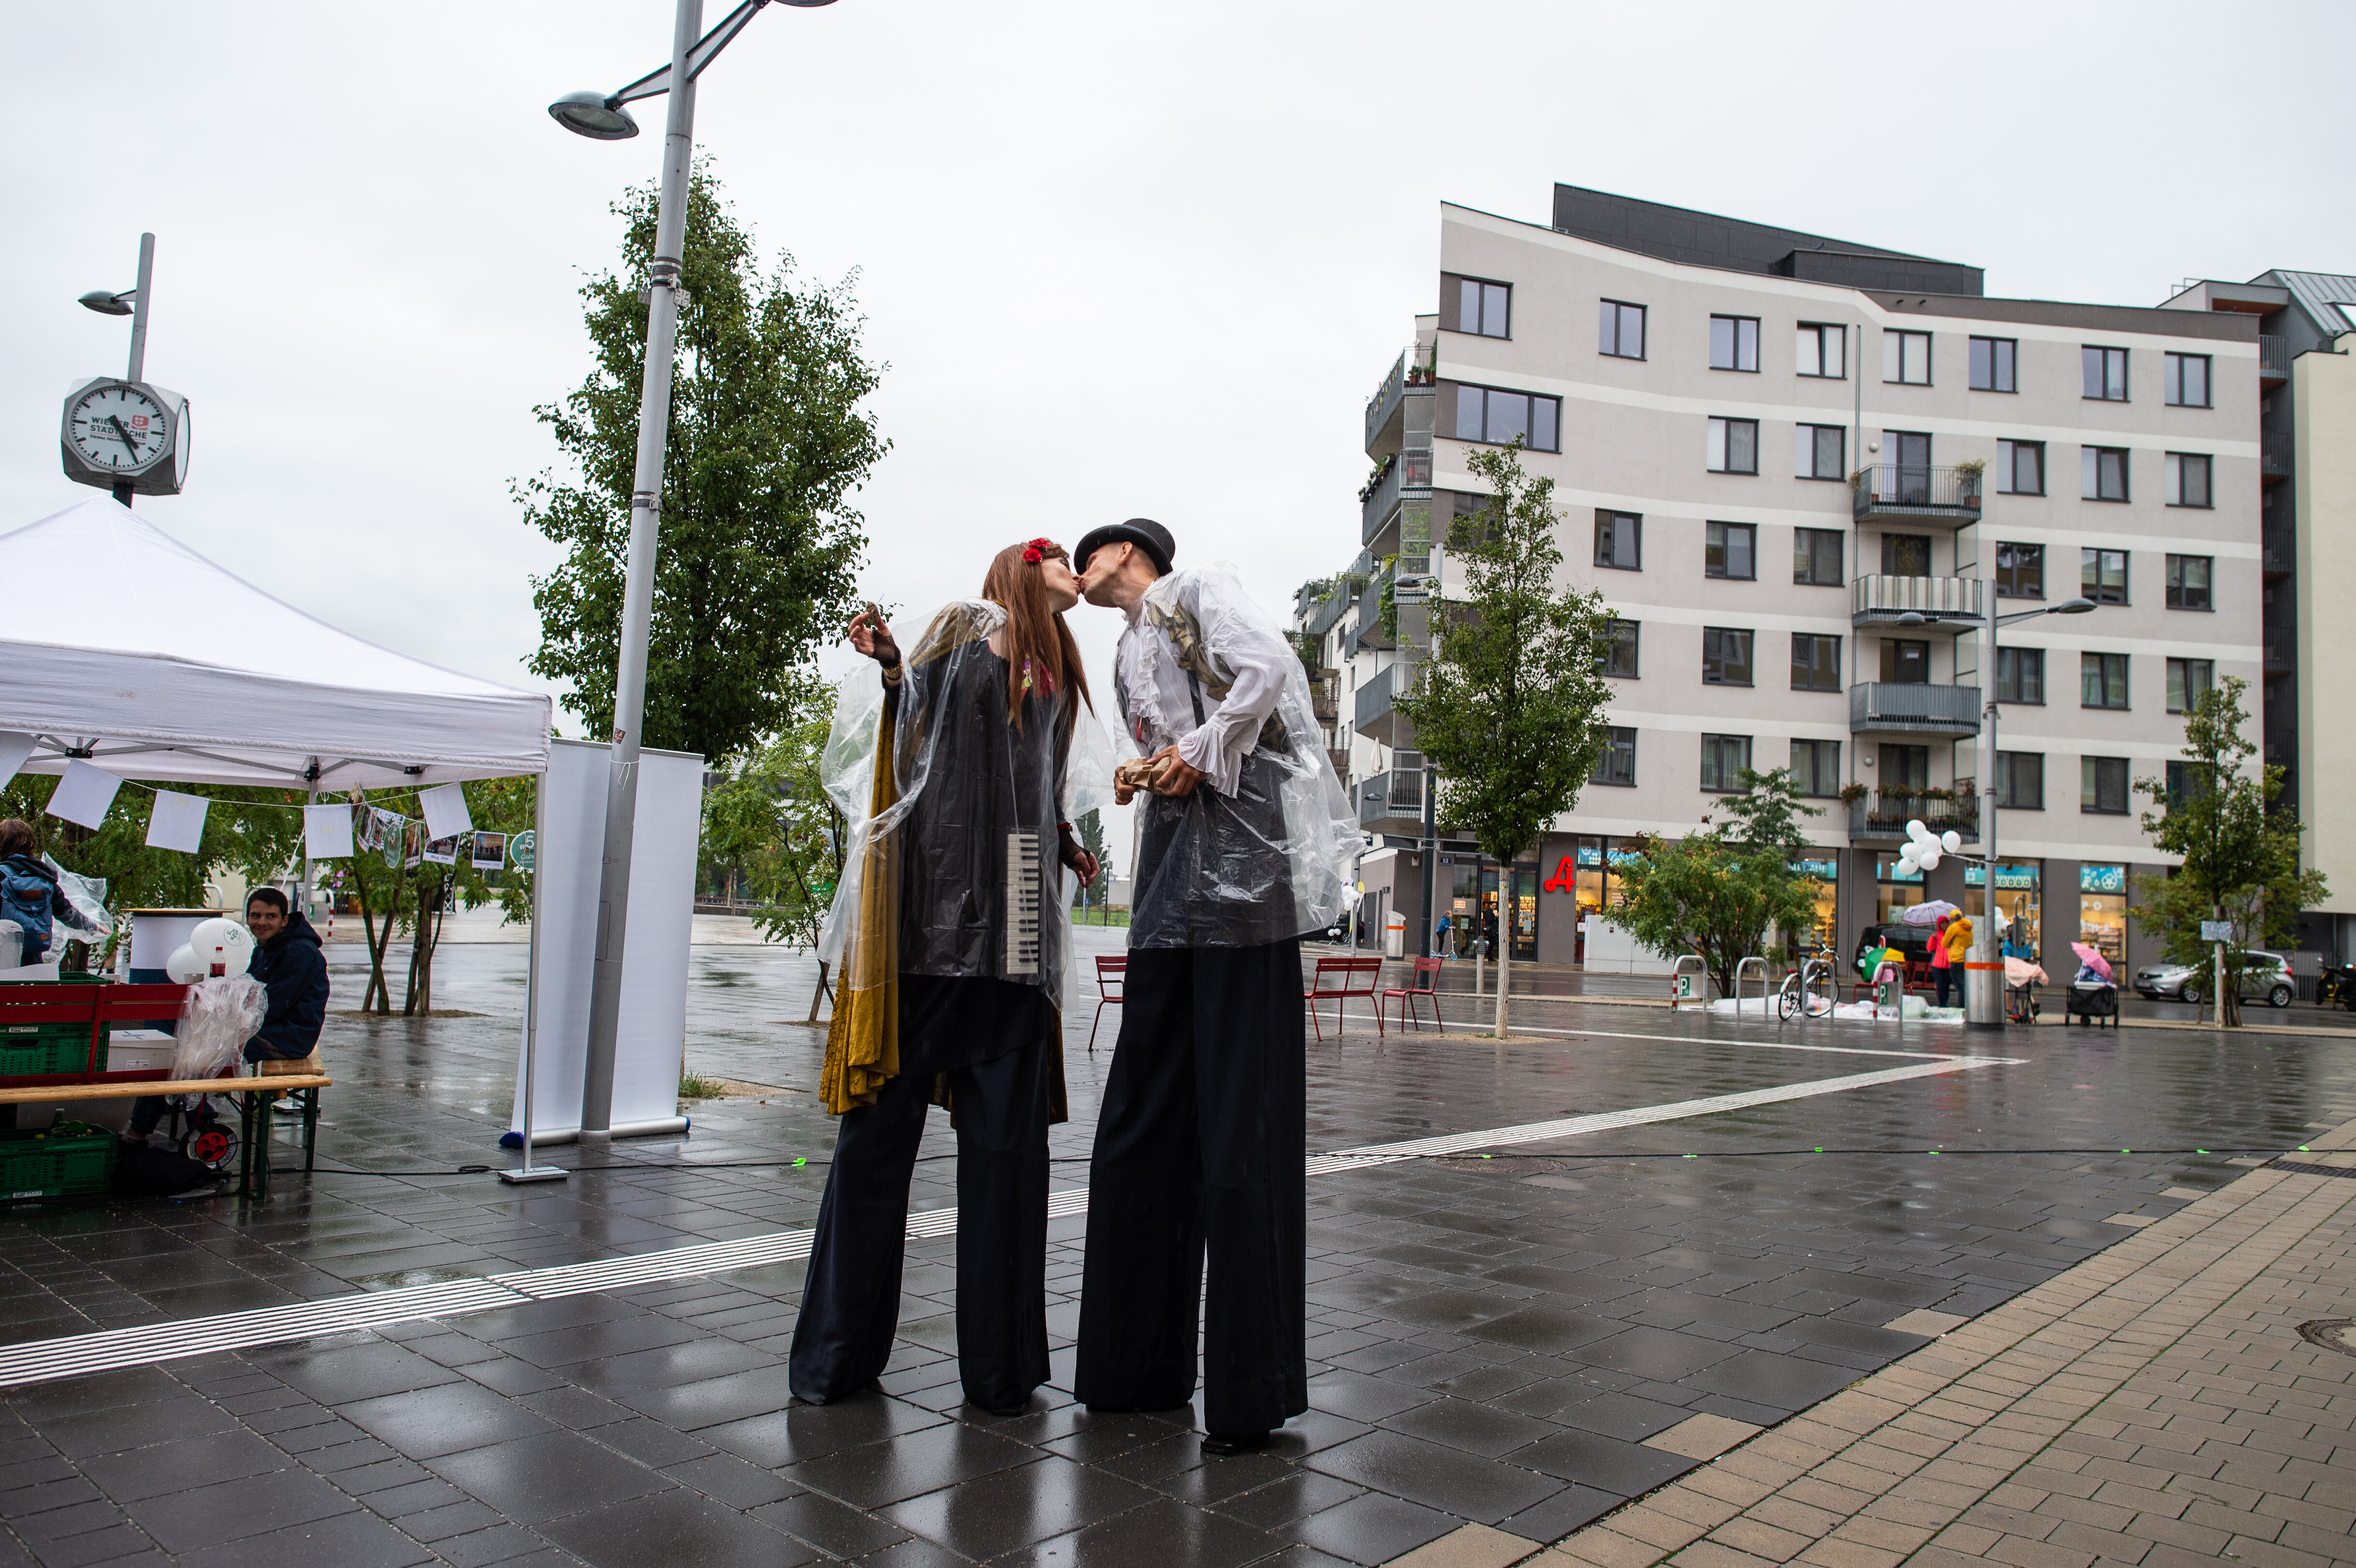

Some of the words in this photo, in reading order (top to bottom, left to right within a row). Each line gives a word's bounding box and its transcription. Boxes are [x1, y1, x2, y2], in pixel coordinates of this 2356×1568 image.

[91, 416, 129, 429] WIER
[90, 425, 147, 439] STÄDCHE
[526, 835, 534, 849] 5
[1681, 978, 1688, 995] P
[1880, 985, 1886, 1004] P
